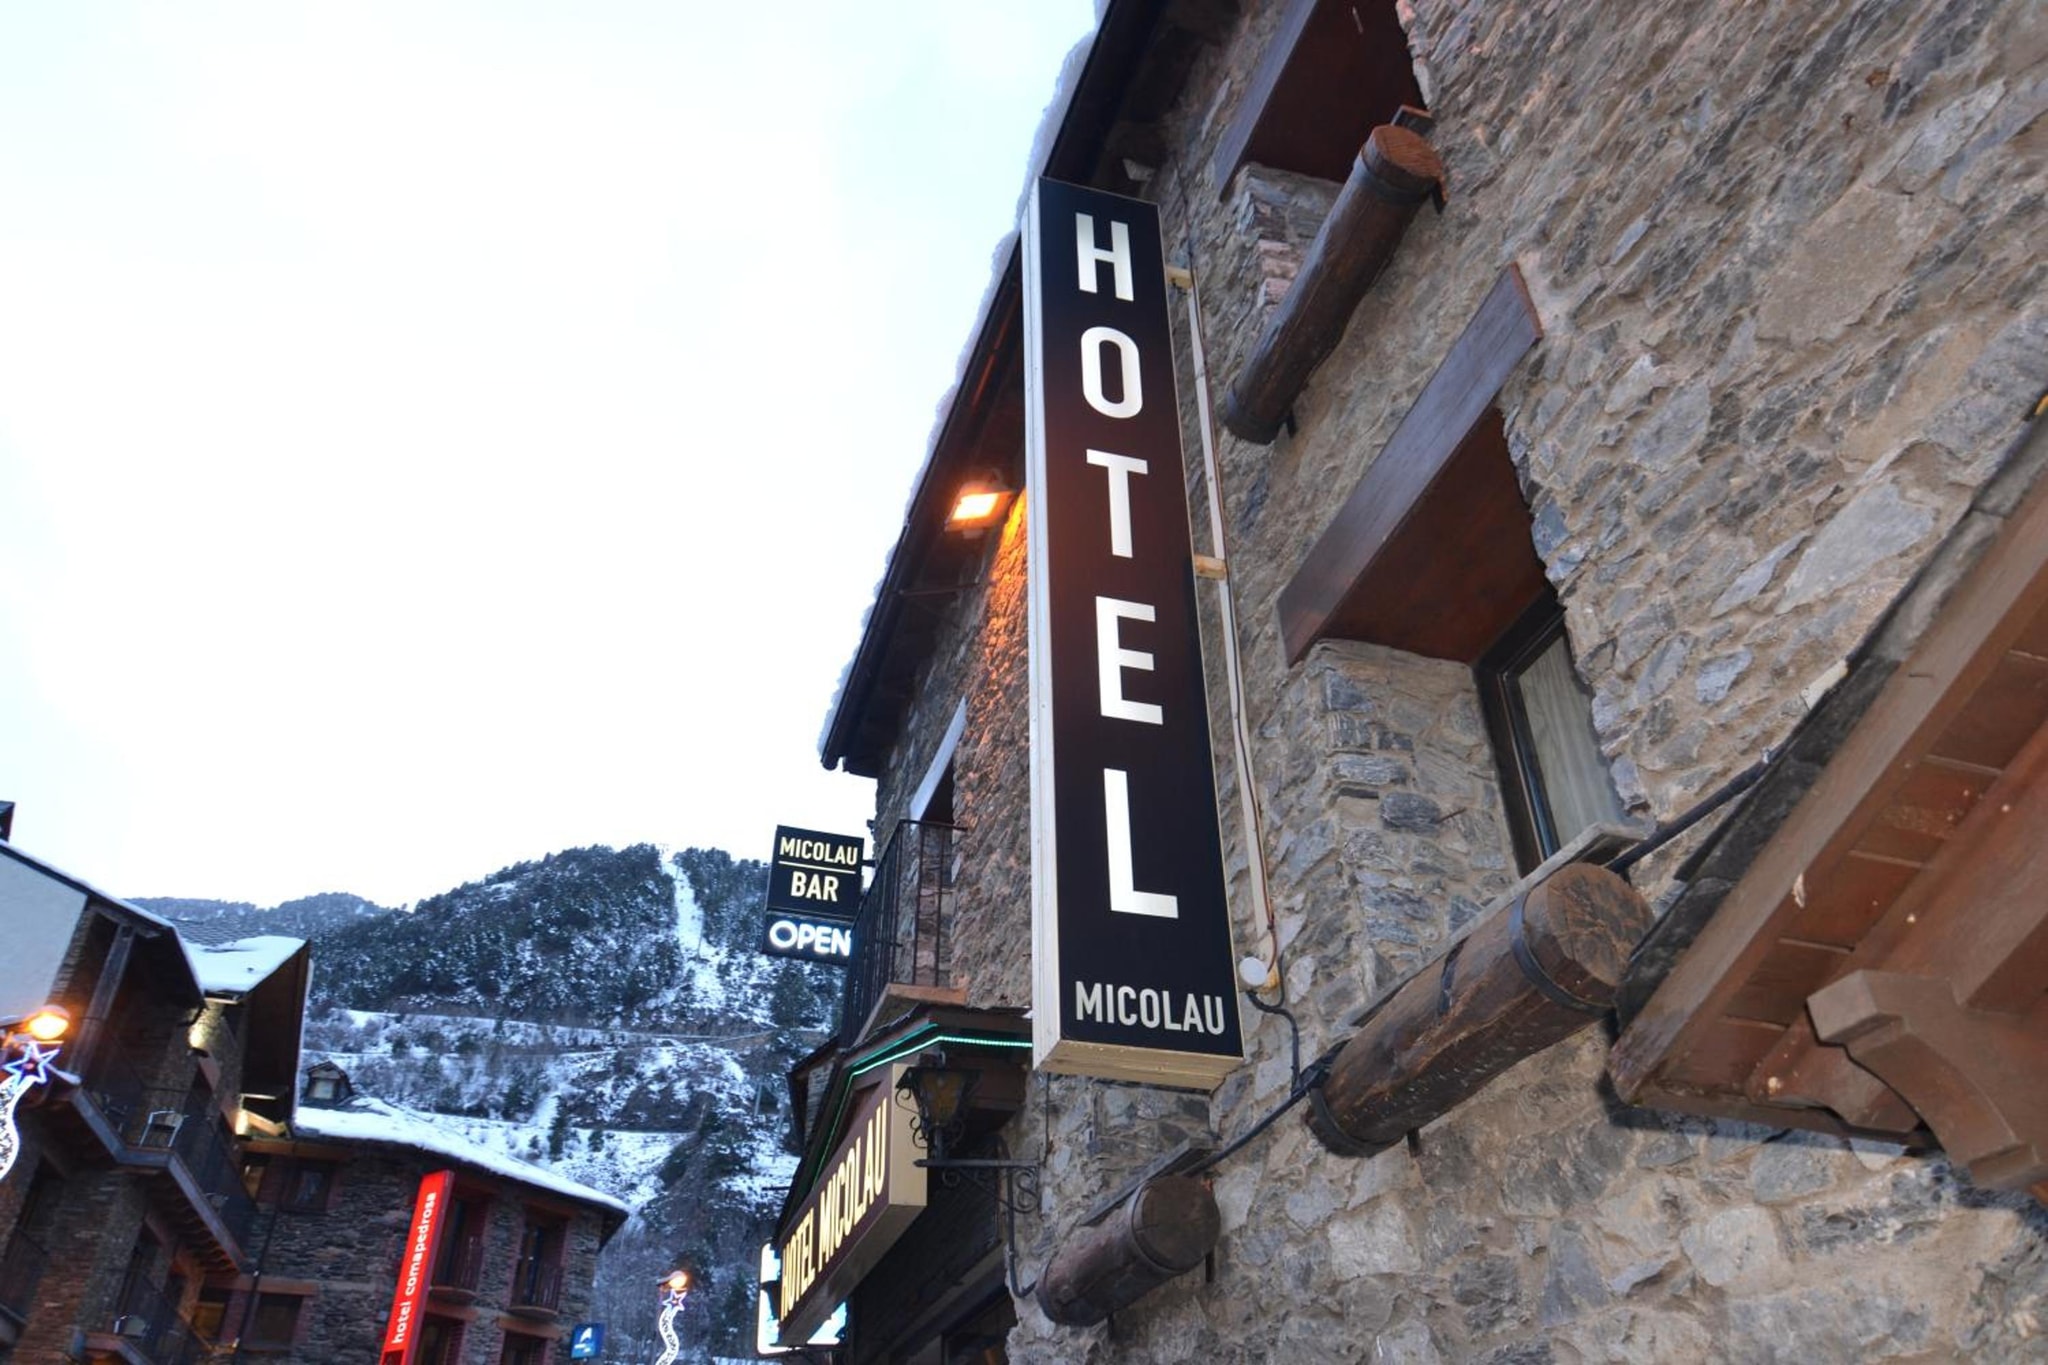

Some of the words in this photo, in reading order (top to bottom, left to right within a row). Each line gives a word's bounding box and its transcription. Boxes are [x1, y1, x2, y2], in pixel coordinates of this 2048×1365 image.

[1076, 213, 1180, 920] HOTEL
[779, 836, 858, 866] MICOLAU
[790, 870, 839, 902] BAR
[769, 919, 852, 957] OPEN
[1075, 980, 1226, 1036] MICOLAU
[780, 1207, 816, 1322] HOTEL
[817, 1097, 888, 1273] MICOLAU
[391, 1300, 412, 1344] hotel
[405, 1191, 437, 1296] comapedrosa
